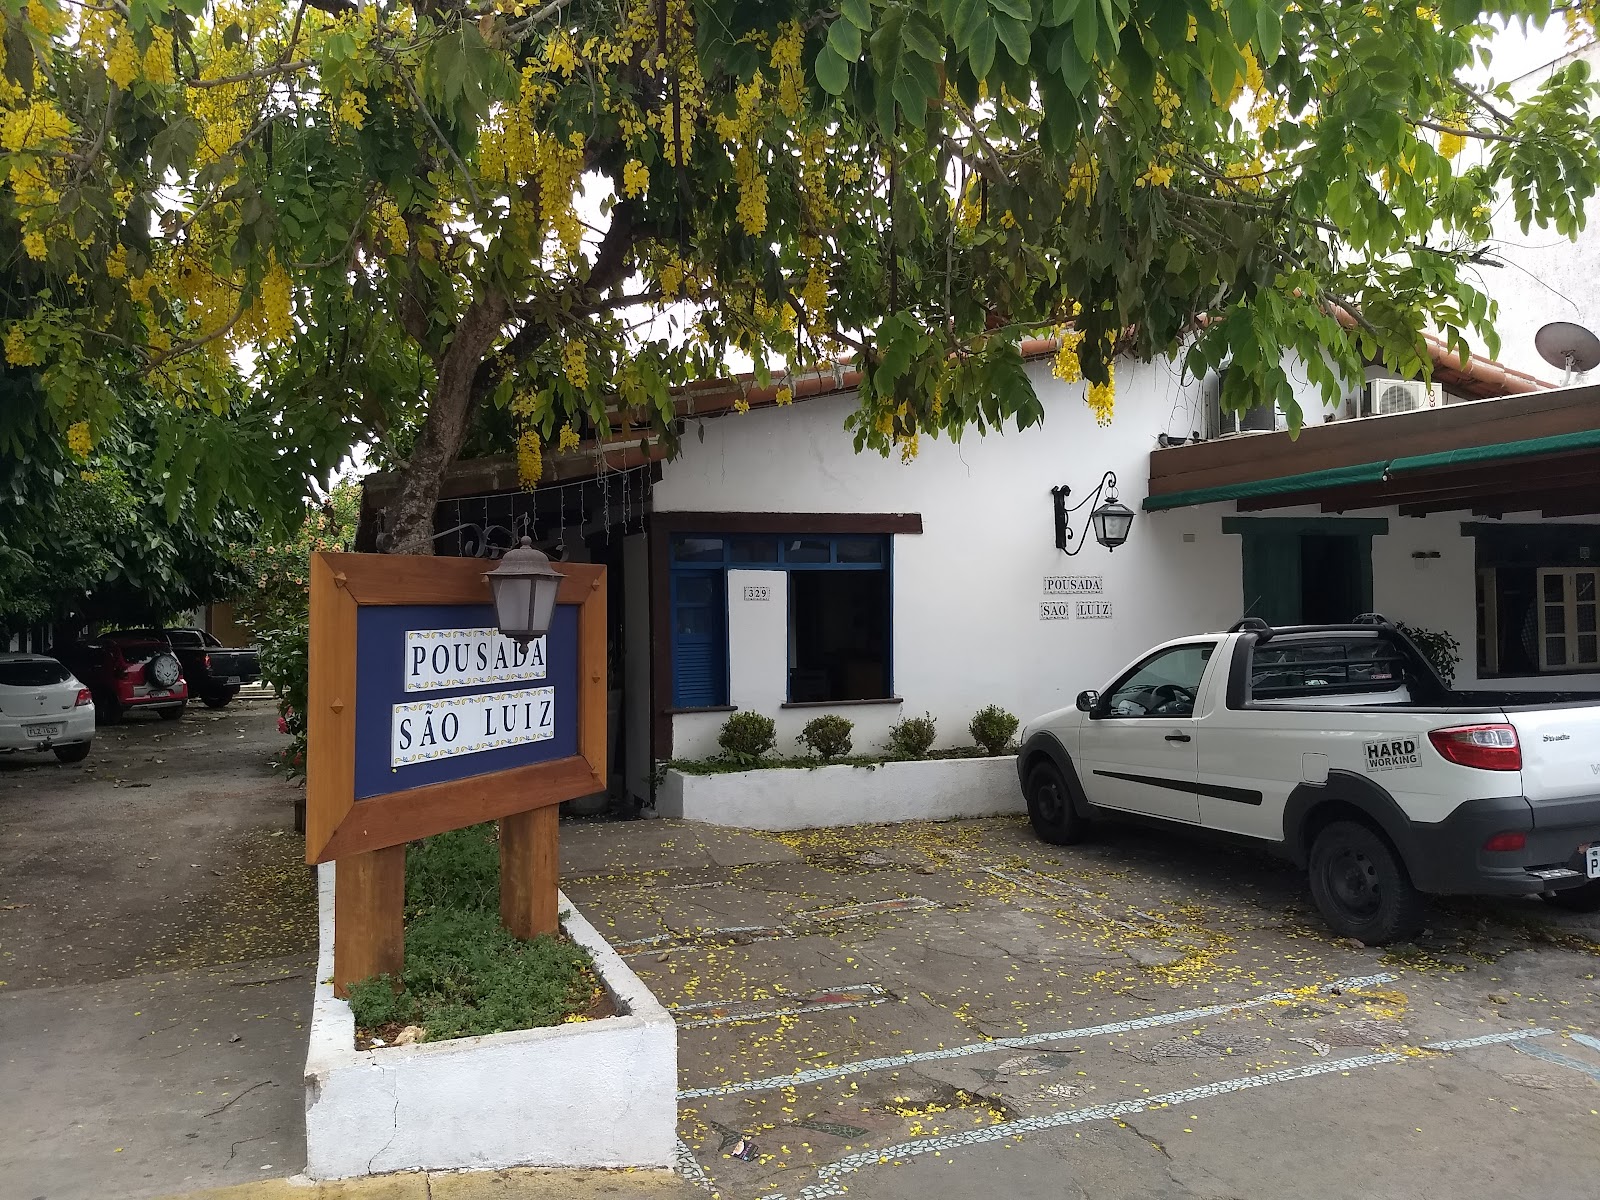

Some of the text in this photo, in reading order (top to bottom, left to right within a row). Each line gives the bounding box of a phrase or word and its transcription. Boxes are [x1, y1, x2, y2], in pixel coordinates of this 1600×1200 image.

[1047, 579, 1100, 590] POUSADA
[748, 589, 767, 598] 329
[1080, 604, 1109, 616] LUIZ
[411, 639, 545, 676] POUSADA
[399, 700, 552, 750] SÃO LUIZ
[1367, 740, 1415, 759] HARD
[1368, 754, 1417, 768] WORKING
